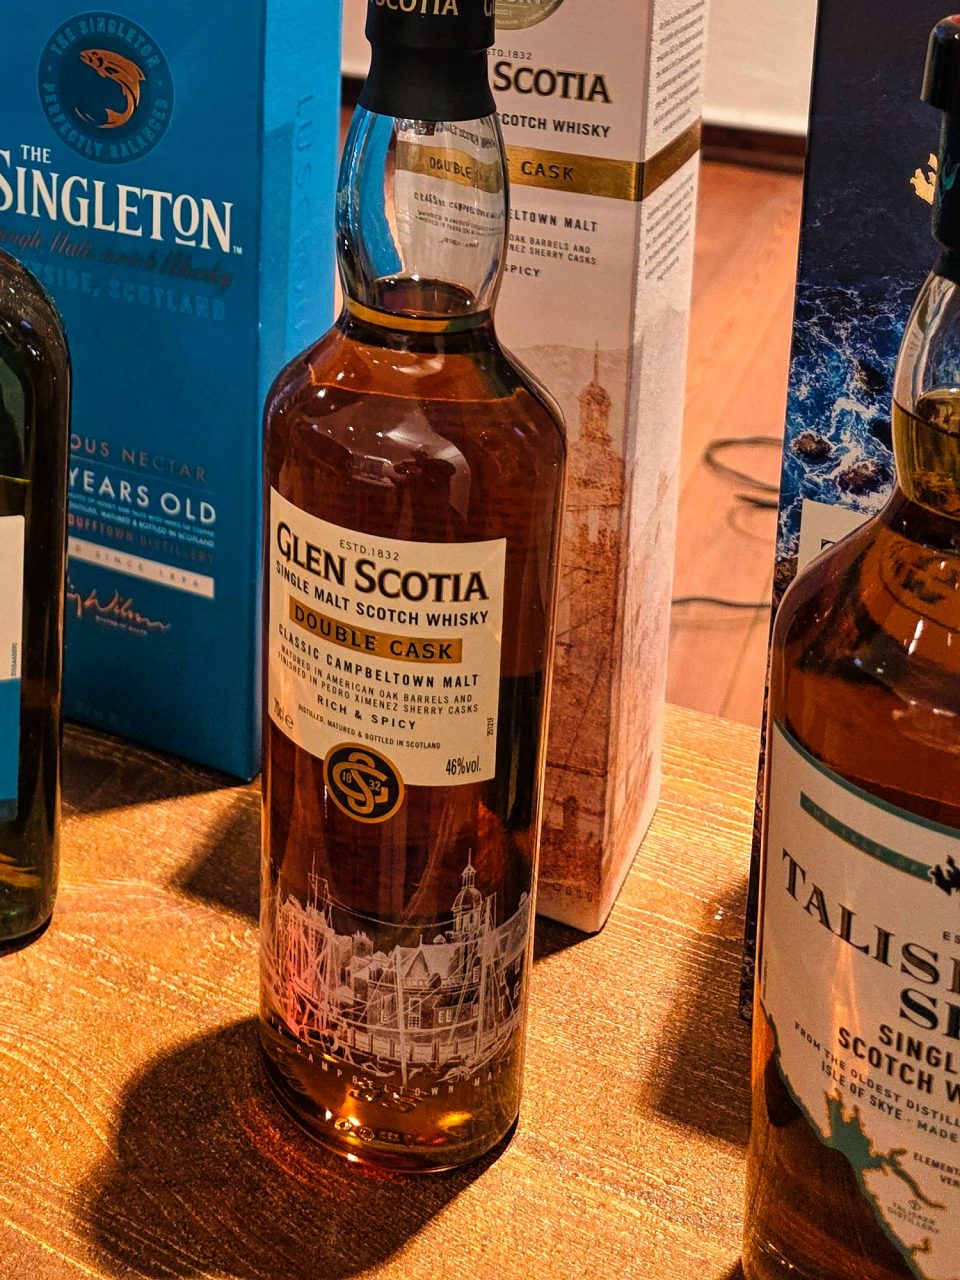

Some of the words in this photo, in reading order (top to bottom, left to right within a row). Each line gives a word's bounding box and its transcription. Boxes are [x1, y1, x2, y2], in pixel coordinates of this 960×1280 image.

[50, 26, 76, 56] THE
[78, 17, 161, 68] SINGLETON
[493, 61, 613, 105] SCOTIA
[43, 83, 103, 157] PERFECTLY
[552, 119, 611, 138] WHISKY
[20, 144, 51, 164] THE
[521, 160, 574, 181] CASK
[529, 236, 569, 252] BARRELS
[573, 242, 591, 254] AND
[564, 216, 598, 233] MALT
[529, 246, 563, 260] SHERRY
[567, 253, 597, 265] CASKS
[122, 447, 205, 482] NECTAR
[68, 467, 149, 508] YEARS
[160, 492, 216, 524] OLD
[276, 521, 347, 587] GLEN
[354, 558, 490, 603] SCOTIA
[339, 539, 400, 561] ESTD.1832
[276, 560, 310, 595] SINGLE
[314, 586, 350, 612] MALT
[356, 602, 419, 626] SCOTCH
[426, 610, 489, 627] WHISKY
[278, 623, 320, 660] CLASSIC
[326, 653, 434, 688] CAMPBELTOWN
[443, 674, 479, 688] MALT
[294, 604, 376, 652] DOUBLE
[390, 640, 453, 660] CASK
[278, 651, 306, 679] FINISHED
[309, 674, 318, 686] IN
[321, 680, 350, 700] PEDRO
[354, 693, 399, 712] XIMENEZ
[403, 704, 443, 715] SHERRY
[448, 703, 479, 715] CASKS
[281, 644, 311, 671] MATURED
[314, 666, 322, 677] IN
[326, 673, 374, 696] AMERICAN
[379, 689, 399, 700] OAK
[403, 692, 449, 705] BARRELS
[454, 694, 473, 704] AND
[317, 694, 347, 715] RICH
[354, 709, 362, 720] &
[371, 714, 416, 730] SPICY
[327, 719, 355, 736] MATURED
[365, 732, 393, 745] BOTTLED
[396, 739, 404, 747] IN
[405, 741, 441, 749] SCOTLAND
[795, 1021, 821, 1051] FROM
[824, 1048, 846, 1070] THE
[850, 1068, 901, 1102] OLDEST
[838, 1026, 934, 1094] SCOTCH
[822, 1061, 845, 1086] ISLE
[850, 1082, 865, 1098] OF
[870, 1094, 902, 1120] SKYE
[917, 1120, 958, 1143] MADE
